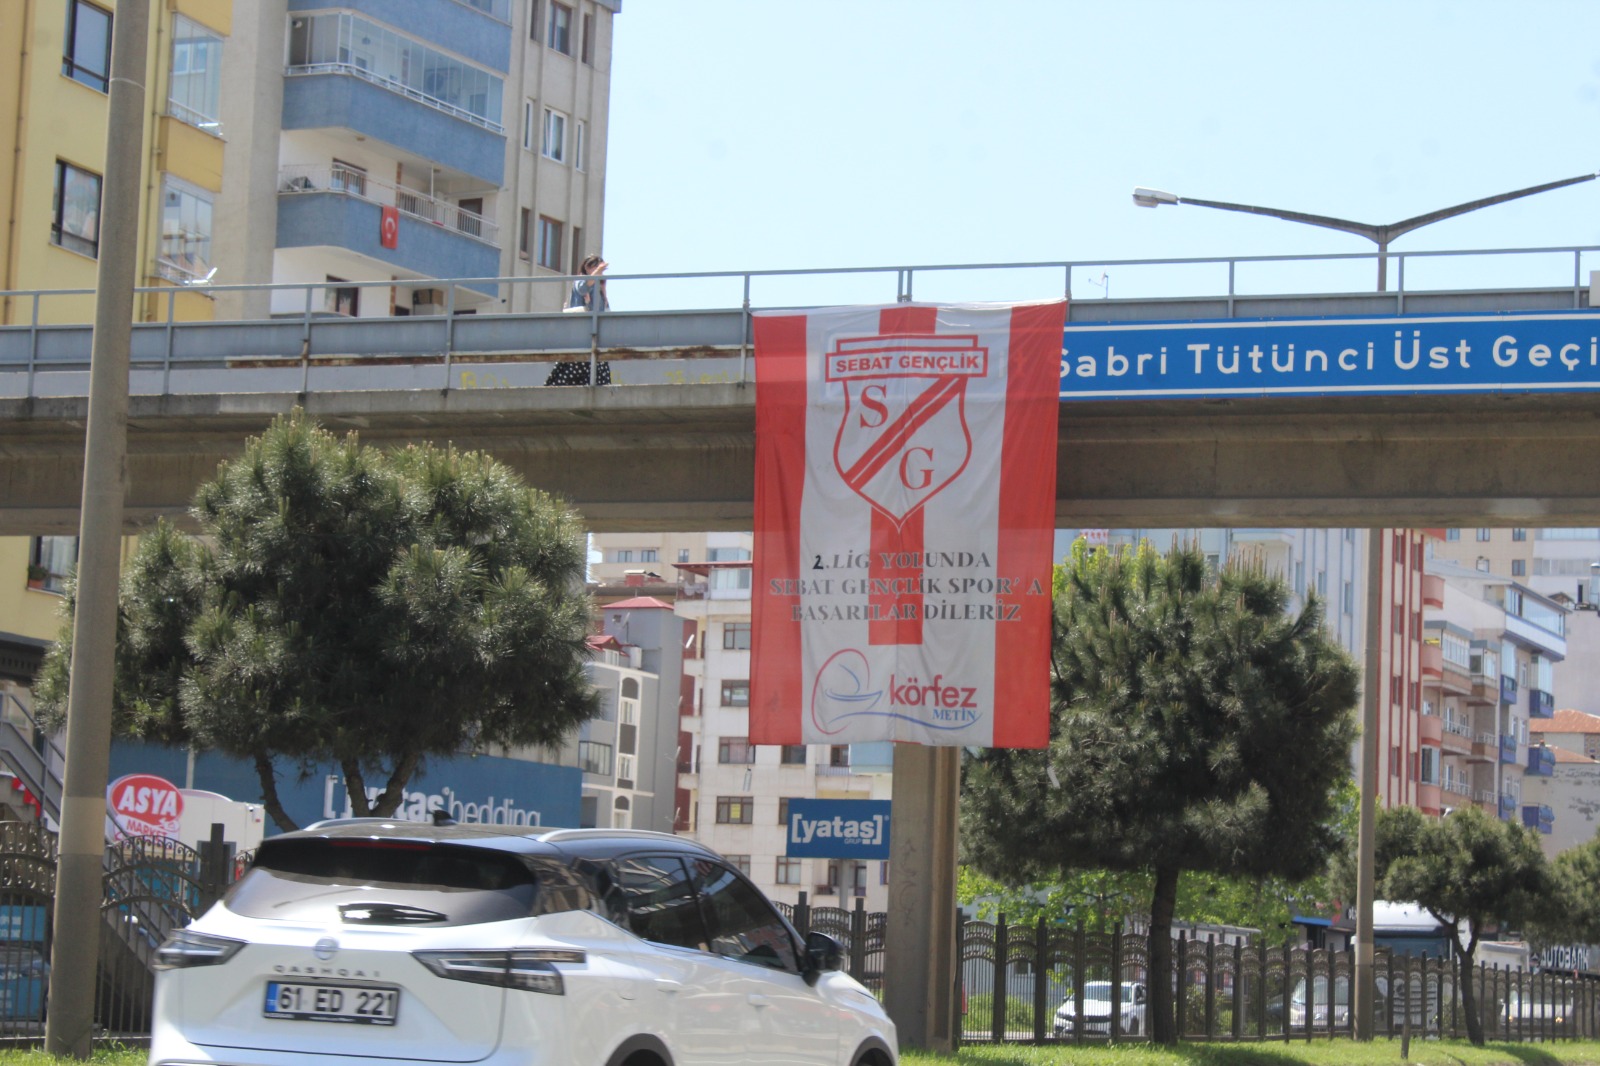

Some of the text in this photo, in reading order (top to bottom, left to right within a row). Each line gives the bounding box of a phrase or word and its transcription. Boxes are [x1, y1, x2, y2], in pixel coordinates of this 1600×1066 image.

[836, 356, 893, 373] SEBAT
[898, 353, 979, 372] GENÇLİK
[1187, 341, 1374, 374] Tütünci
[1394, 330, 1471, 370] Üst
[860, 384, 888, 429] S
[899, 447, 935, 490] G
[879, 551, 991, 569] YOLUNDA
[769, 578, 834, 596] SEBAT
[842, 574, 942, 599] GENÇLİK
[791, 600, 1021, 624] BAŞARILAR DİLERİZ
[889, 674, 977, 708] körfez
[932, 708, 976, 721] METİN
[118, 785, 177, 816] ASYA
[273, 964, 381, 978] QASHQAI
[279, 986, 395, 1017] 61 ED 221
